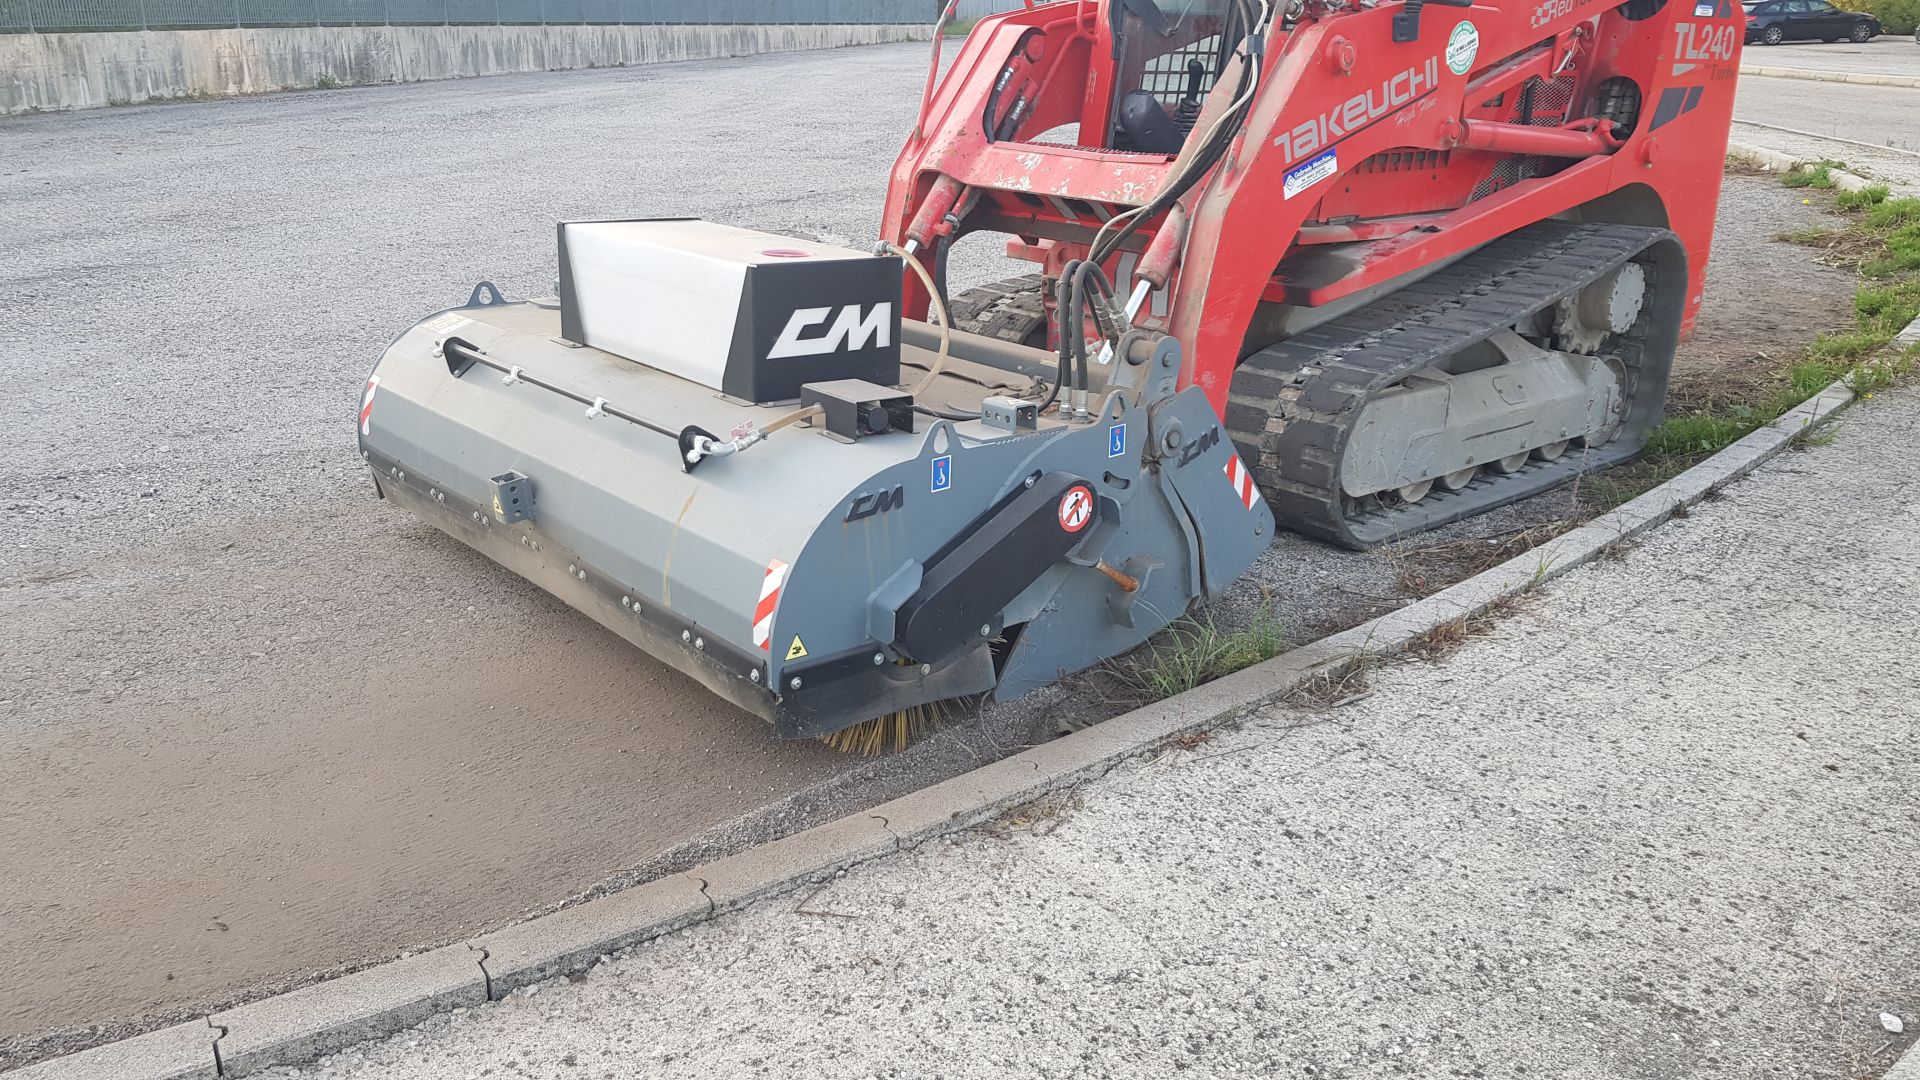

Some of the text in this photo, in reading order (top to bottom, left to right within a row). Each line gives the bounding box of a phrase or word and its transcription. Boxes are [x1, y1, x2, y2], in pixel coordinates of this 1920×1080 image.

[1675, 22, 1736, 61] TL240
[766, 301, 892, 360] CM
[844, 485, 904, 523] CM
